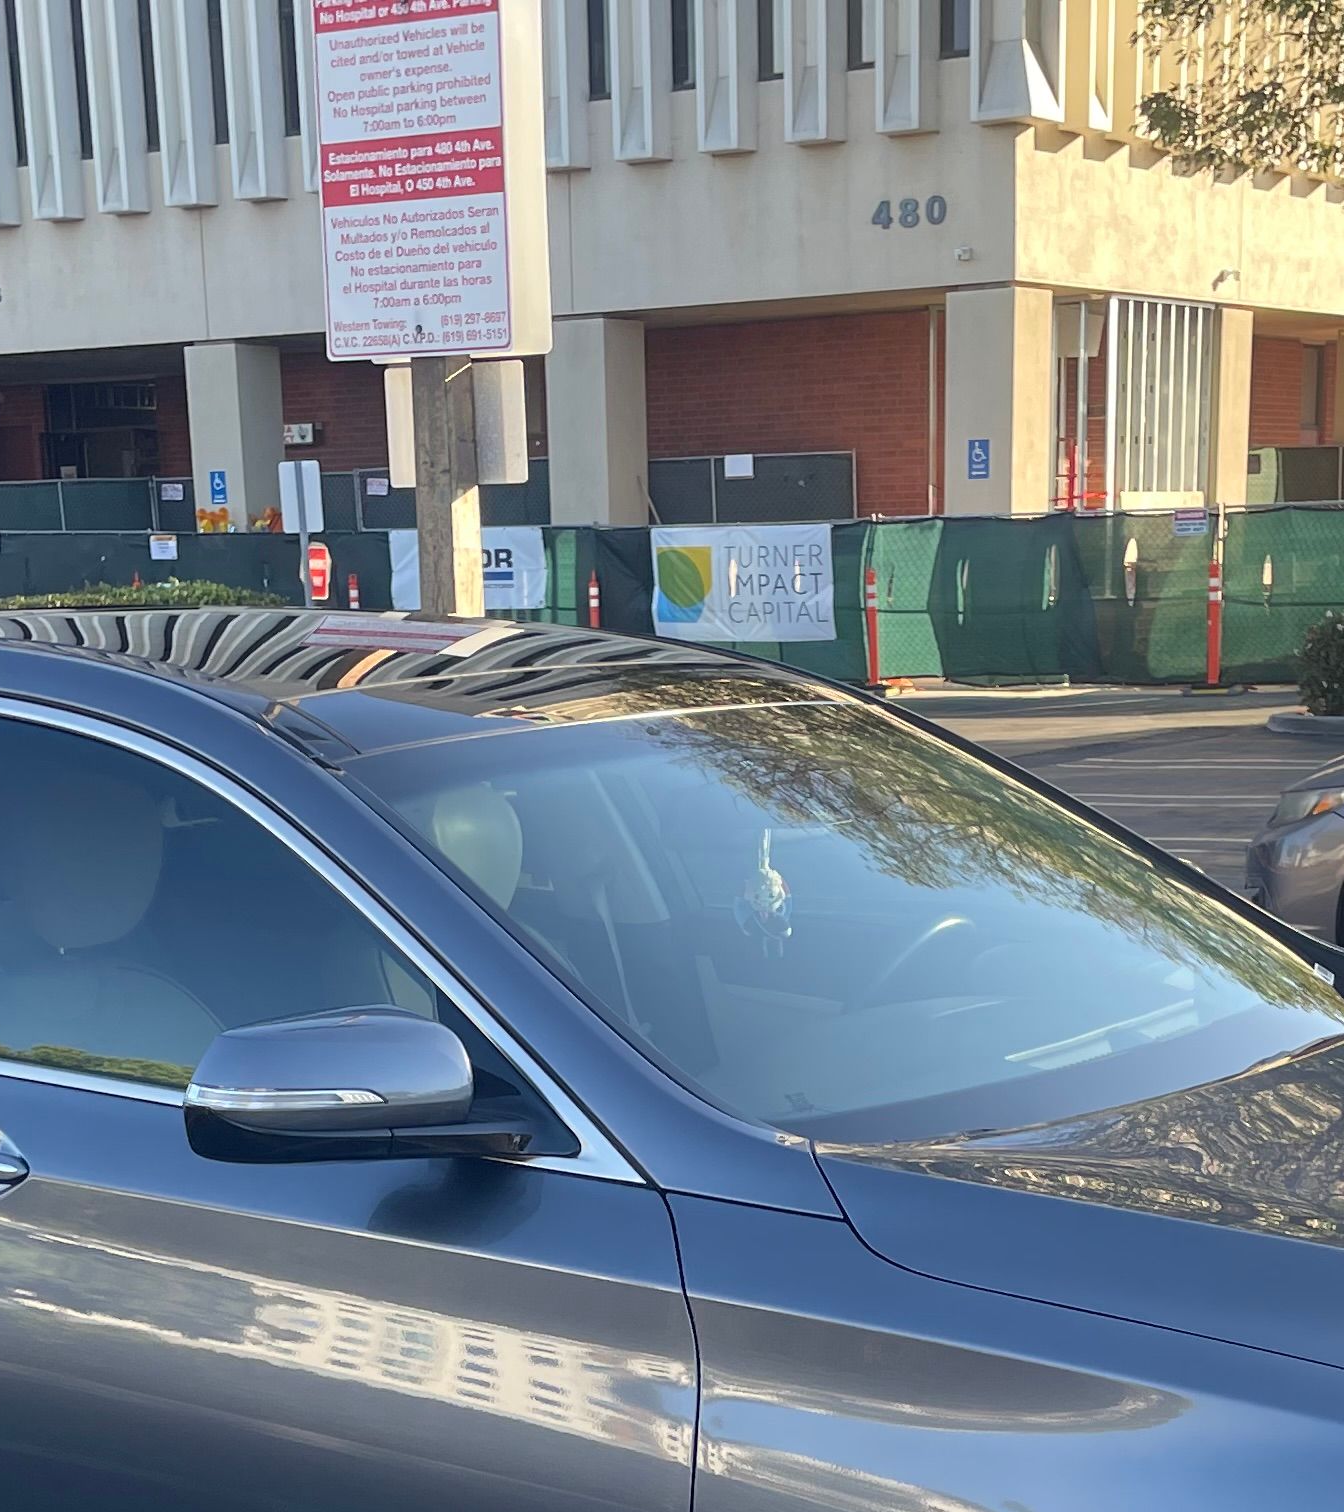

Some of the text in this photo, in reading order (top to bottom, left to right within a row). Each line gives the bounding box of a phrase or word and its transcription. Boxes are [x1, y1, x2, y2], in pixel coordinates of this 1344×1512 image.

[320, 12, 334, 24] No
[336, 5, 376, 23] Hospital
[378, 7, 389, 17] or
[329, 22, 485, 51] Unauthorized Vehicles will be
[330, 39, 485, 68] cited and/or towed at Vehicle
[359, 62, 453, 82] owner's expense.
[327, 73, 491, 104] Open public parking prohibited
[333, 93, 487, 118] No Hospital parking between
[362, 113, 456, 133] 7:00am to 6:00pm
[328, 147, 409, 166] Estacionamiento
[410, 145, 433, 160] para
[454, 139, 471, 152] 4th
[472, 138, 494, 151] Ave.
[323, 156, 502, 183] Solamente. No Estacionamiento para
[349, 184, 360, 197] El
[435, 176, 452, 189] 4th
[453, 174, 476, 187] Ave.
[330, 206, 499, 230] Vehiculos No Autorizados Seran
[871, 195, 947, 229] 480
[340, 222, 490, 245] Multados y/o Remolcados al
[335, 239, 498, 262] Costo de el Dueño del vehiculo
[350, 258, 482, 277] No estacionamiento para
[343, 273, 492, 295] el Hospital durante las horas
[373, 293, 462, 308] 7:00am a 6:00pm
[334, 320, 370, 332] Western
[372, 318, 407, 331] Towing:
[440, 313, 462, 327] (619)
[334, 336, 361, 348] C.V.C.
[442, 330, 464, 345] (619)
[723, 544, 823, 568] TURNER
[728, 573, 823, 596] IMPACT
[728, 601, 828, 624] CAPITAL
